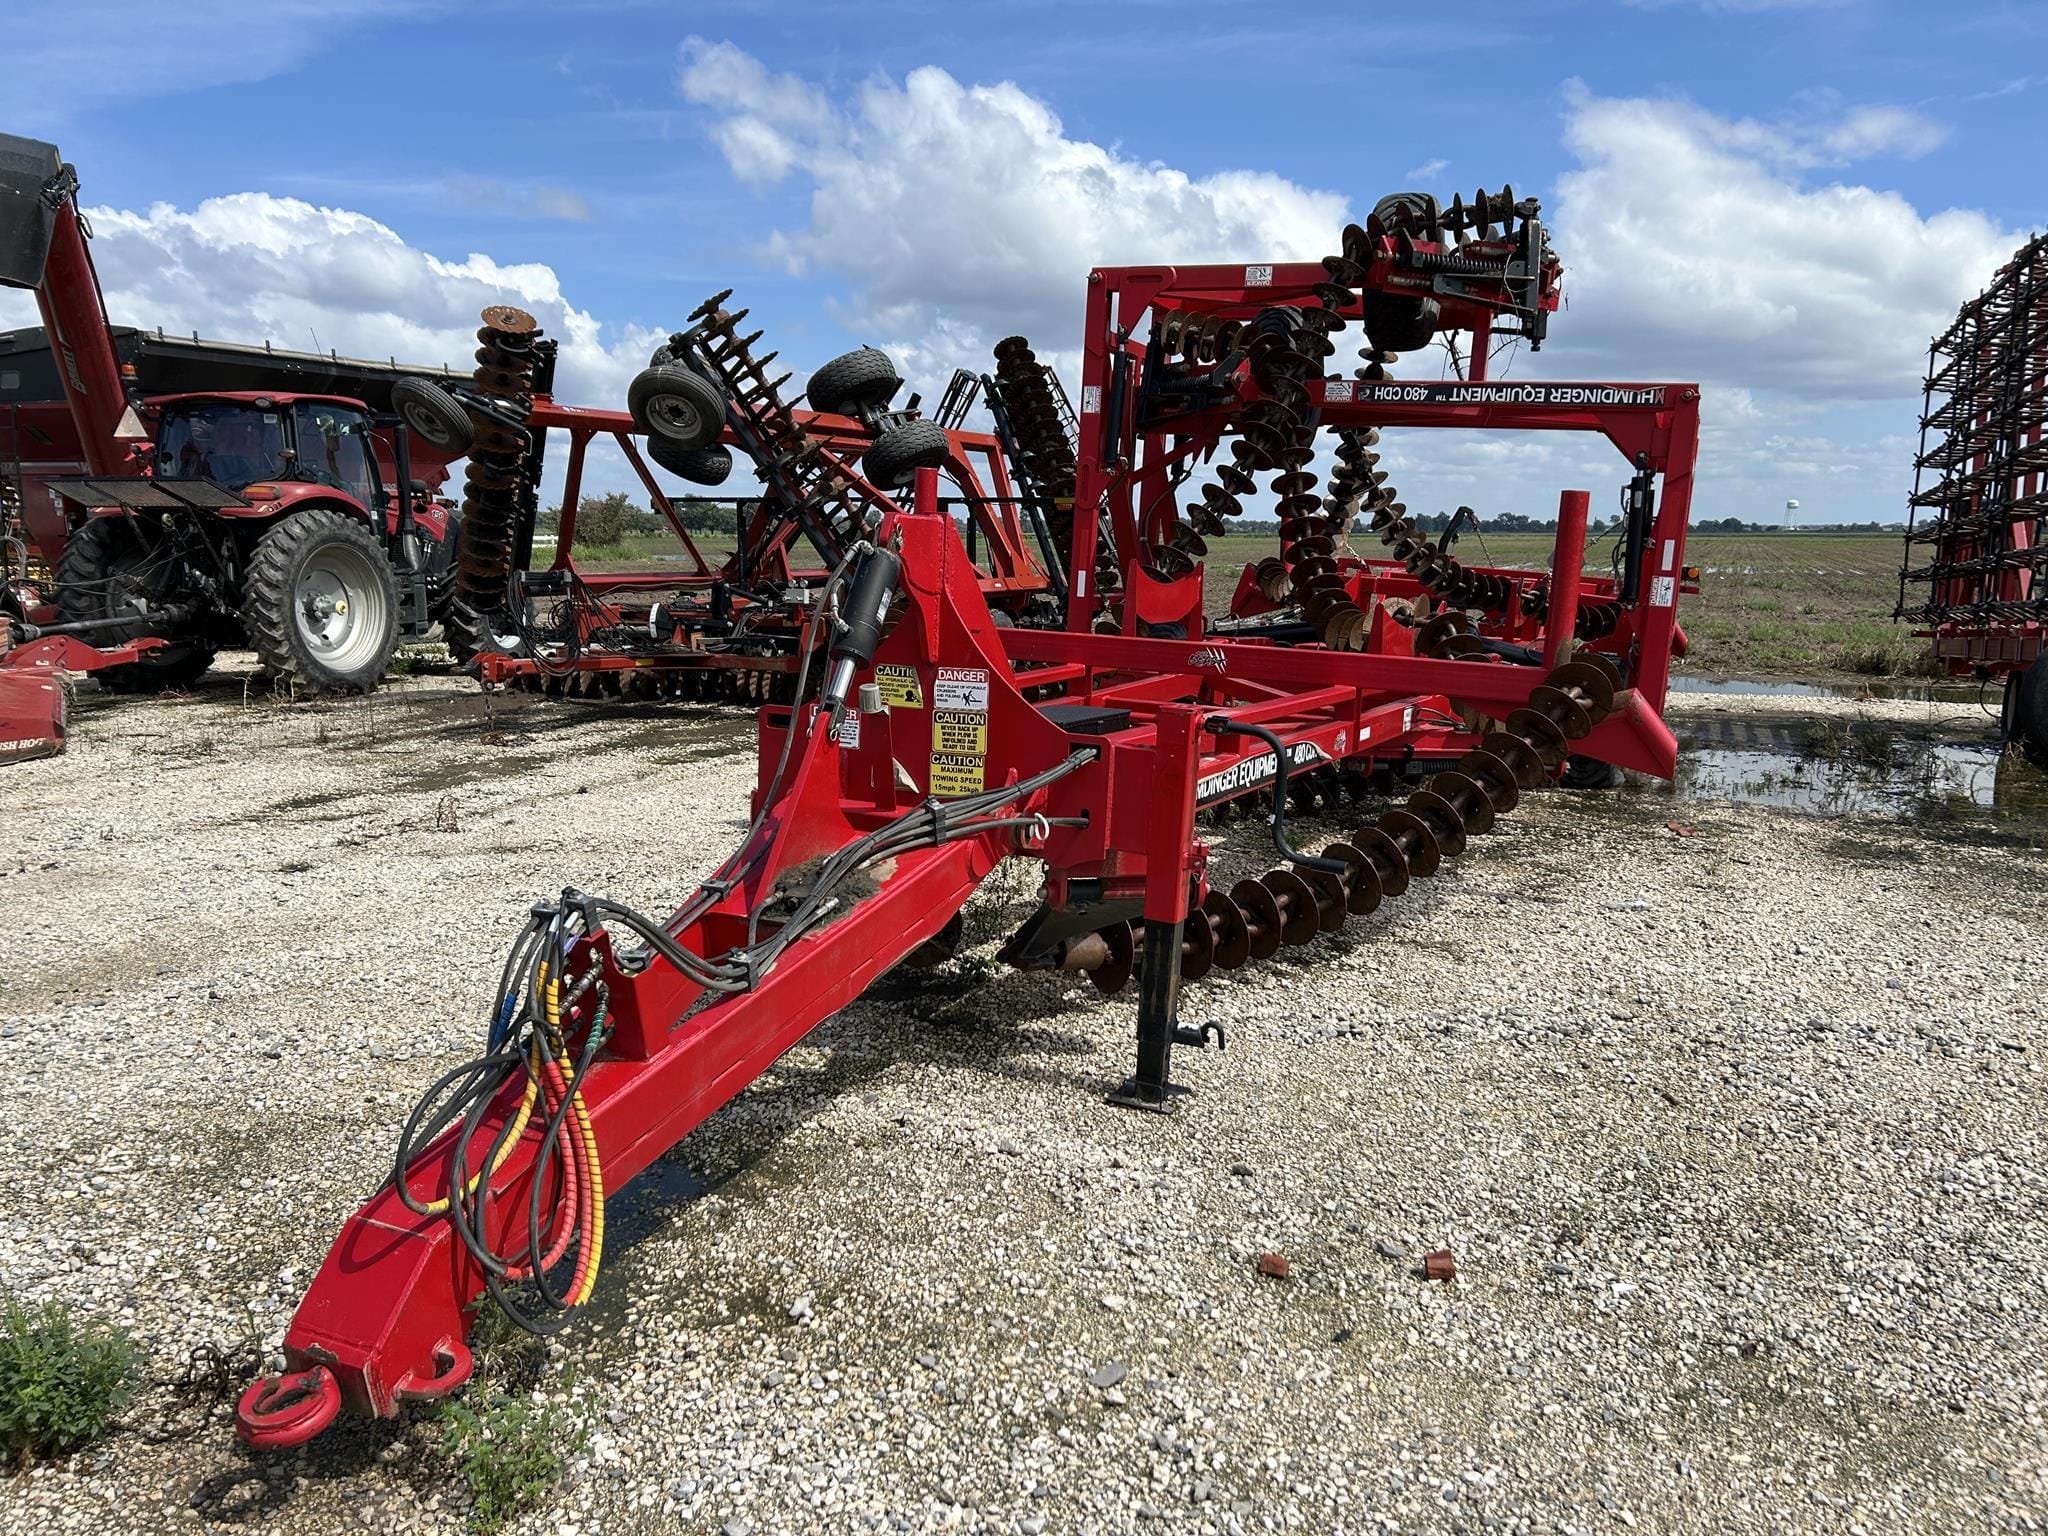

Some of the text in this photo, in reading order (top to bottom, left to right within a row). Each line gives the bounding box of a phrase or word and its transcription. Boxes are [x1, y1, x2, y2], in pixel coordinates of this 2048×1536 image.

[1375, 386, 1401, 400] CDH
[1404, 386, 1429, 401] 480
[1449, 384, 1545, 402] EQUIPMENT
[1550, 387, 1654, 404] HUMDINGER
[938, 669, 985, 682] DANGER
[935, 712, 985, 725] CAUTION
[931, 754, 983, 767] CAUTION
[1294, 743, 1306, 765] 480
[940, 765, 974, 774] MAXIMUM
[932, 774, 982, 785] TOWING SPEED
[934, 783, 979, 794] 15mph 25kph
